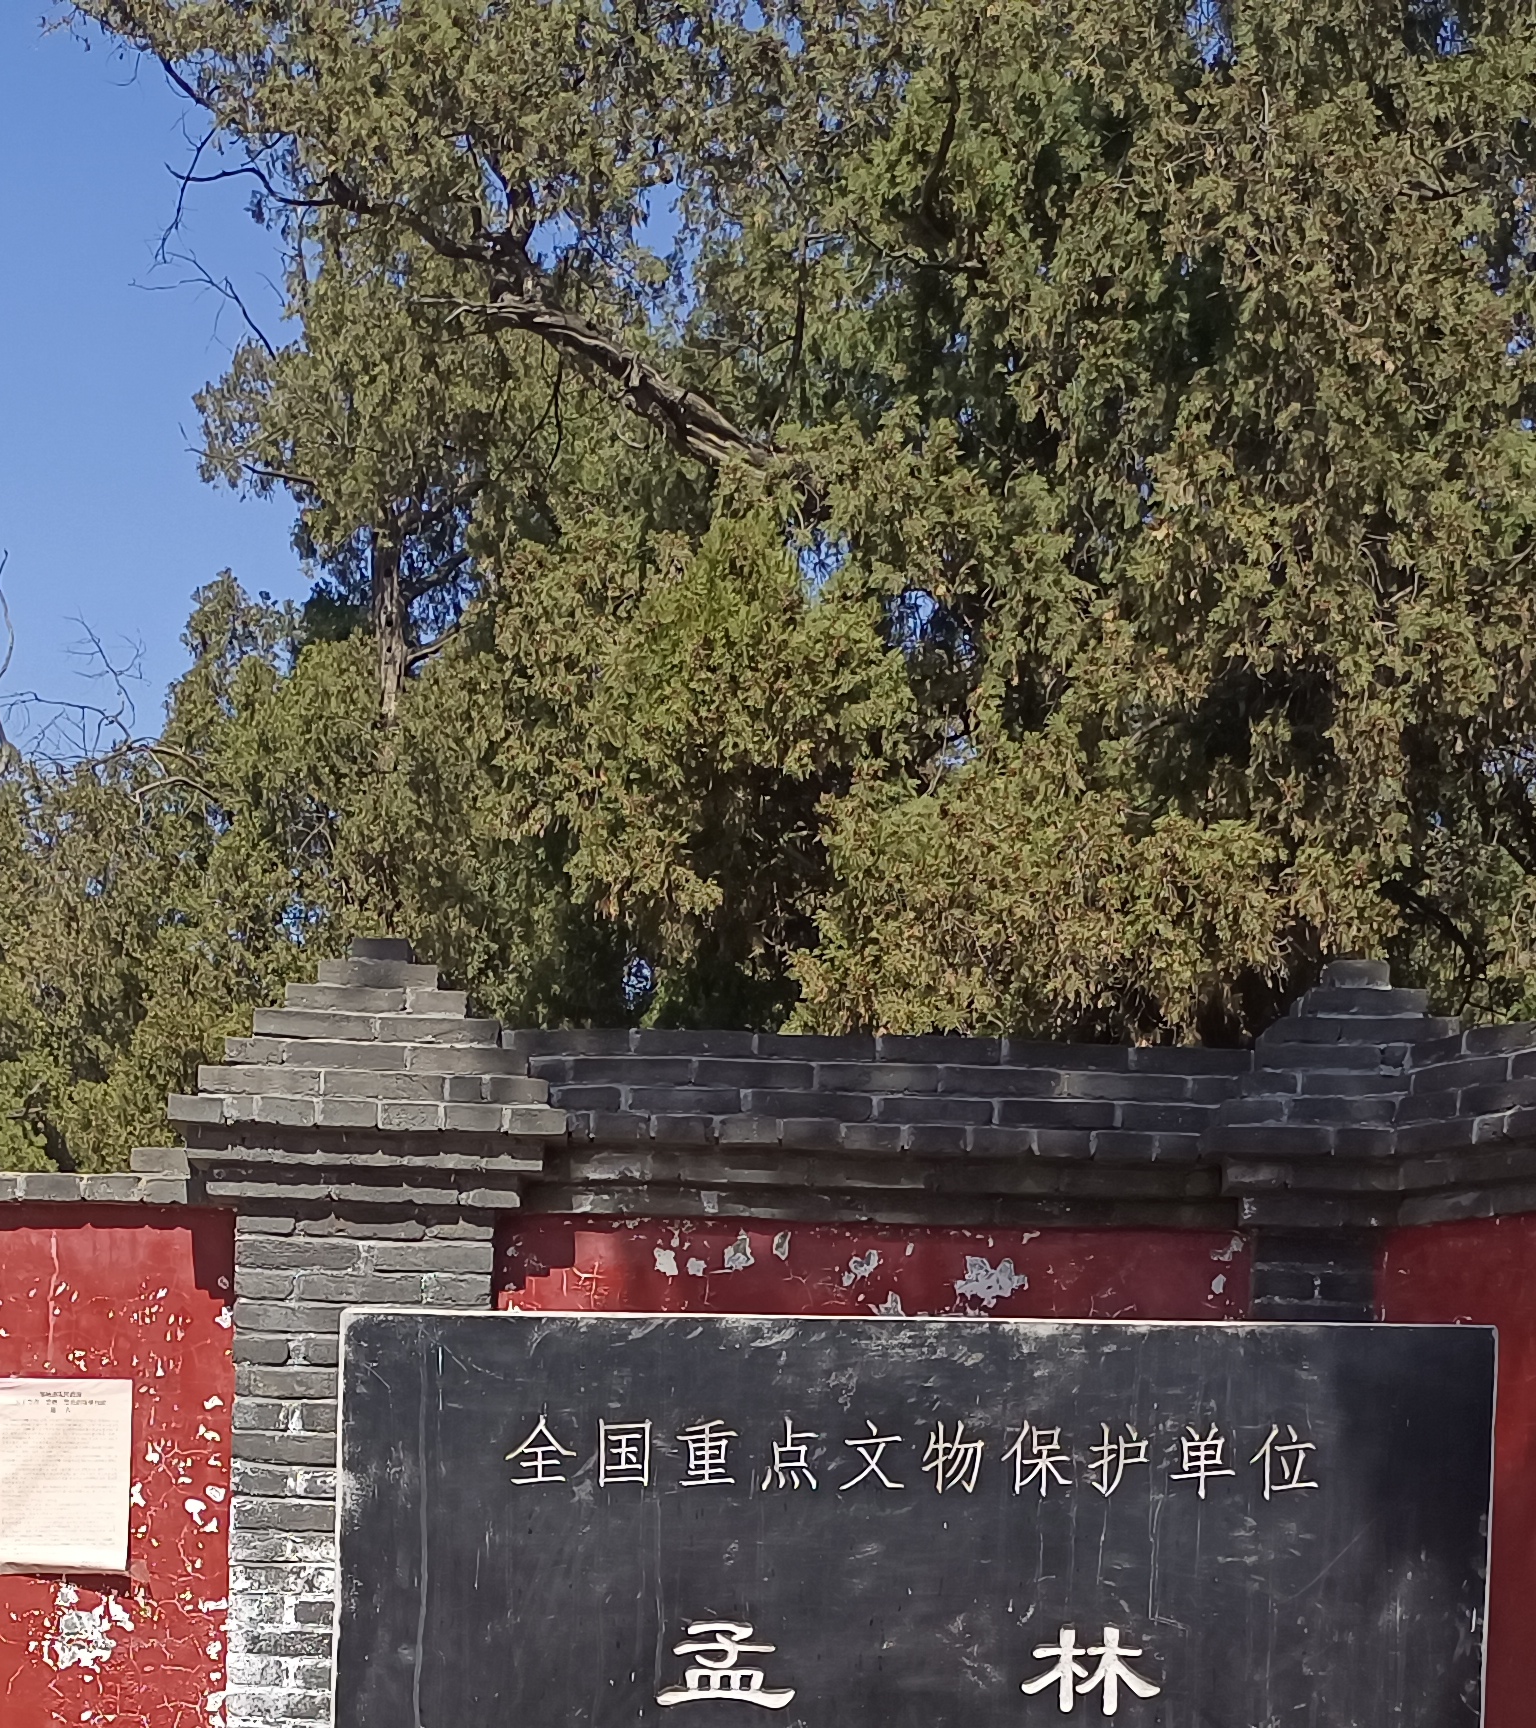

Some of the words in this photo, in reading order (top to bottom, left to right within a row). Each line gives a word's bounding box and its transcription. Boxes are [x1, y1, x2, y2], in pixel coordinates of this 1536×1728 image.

[504, 1416, 1322, 1502] 全国重点文物保护单位
[656, 1620, 797, 1711] 孟
[1020, 1626, 1162, 1716] 林
